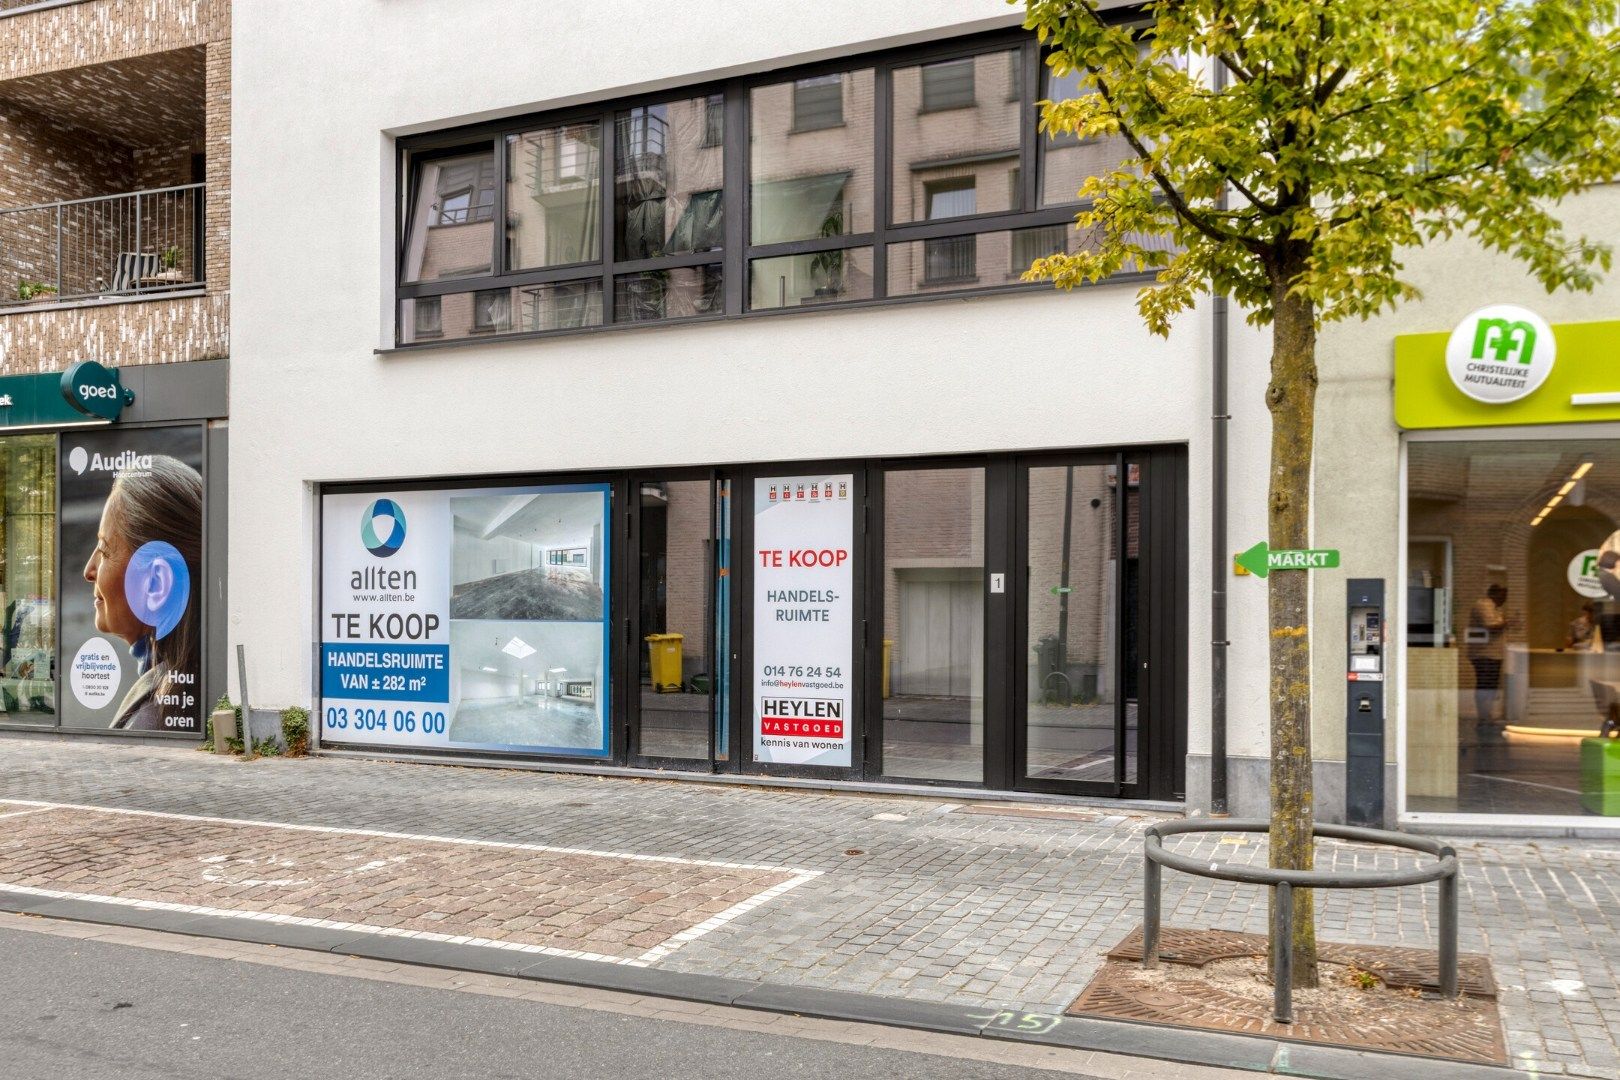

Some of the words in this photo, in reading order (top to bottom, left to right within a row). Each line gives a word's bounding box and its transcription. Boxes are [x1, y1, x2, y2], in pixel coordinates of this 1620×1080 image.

[1466, 362, 1529, 377] CHRISTELIJKE
[1464, 374, 1526, 388] MUTUALITEIT
[79, 383, 117, 400] goed
[90, 450, 152, 471] Audika
[759, 550, 782, 567] TE
[789, 549, 848, 567] KOOP
[1267, 552, 1329, 567] MARKT
[350, 566, 417, 590] allten
[994, 577, 1000, 588] 1
[352, 593, 415, 602] www.allten.be
[767, 590, 840, 603] HANDELS-
[776, 609, 829, 622] RUIMTE
[331, 613, 361, 639] TE
[369, 613, 440, 640] KOOP
[80, 653, 100, 662] gratis
[328, 652, 444, 670] HANDELSRUIMTE
[76, 662, 117, 671] vrijblijvende
[764, 665, 785, 677] 014
[788, 666, 803, 677] 76
[806, 667, 822, 678] 24
[825, 667, 842, 678] 54
[82, 672, 111, 680] hoortest
[168, 670, 194, 684] Hou
[340, 673, 369, 690] VAN
[383, 675, 406, 691] 282
[761, 679, 844, 690] info@heylenvastgoed.be
[156, 694, 180, 706] van
[182, 692, 194, 708] je
[763, 700, 841, 718] HEYLEN
[165, 716, 194, 728] oren
[327, 706, 349, 729] 03
[354, 708, 387, 731] 304
[393, 710, 416, 732] 06
[422, 711, 445, 734] 00
[763, 721, 841, 733] VASTGOED
[760, 736, 791, 748] kennis
[793, 740, 809, 749] van
[811, 741, 844, 751] wonen
